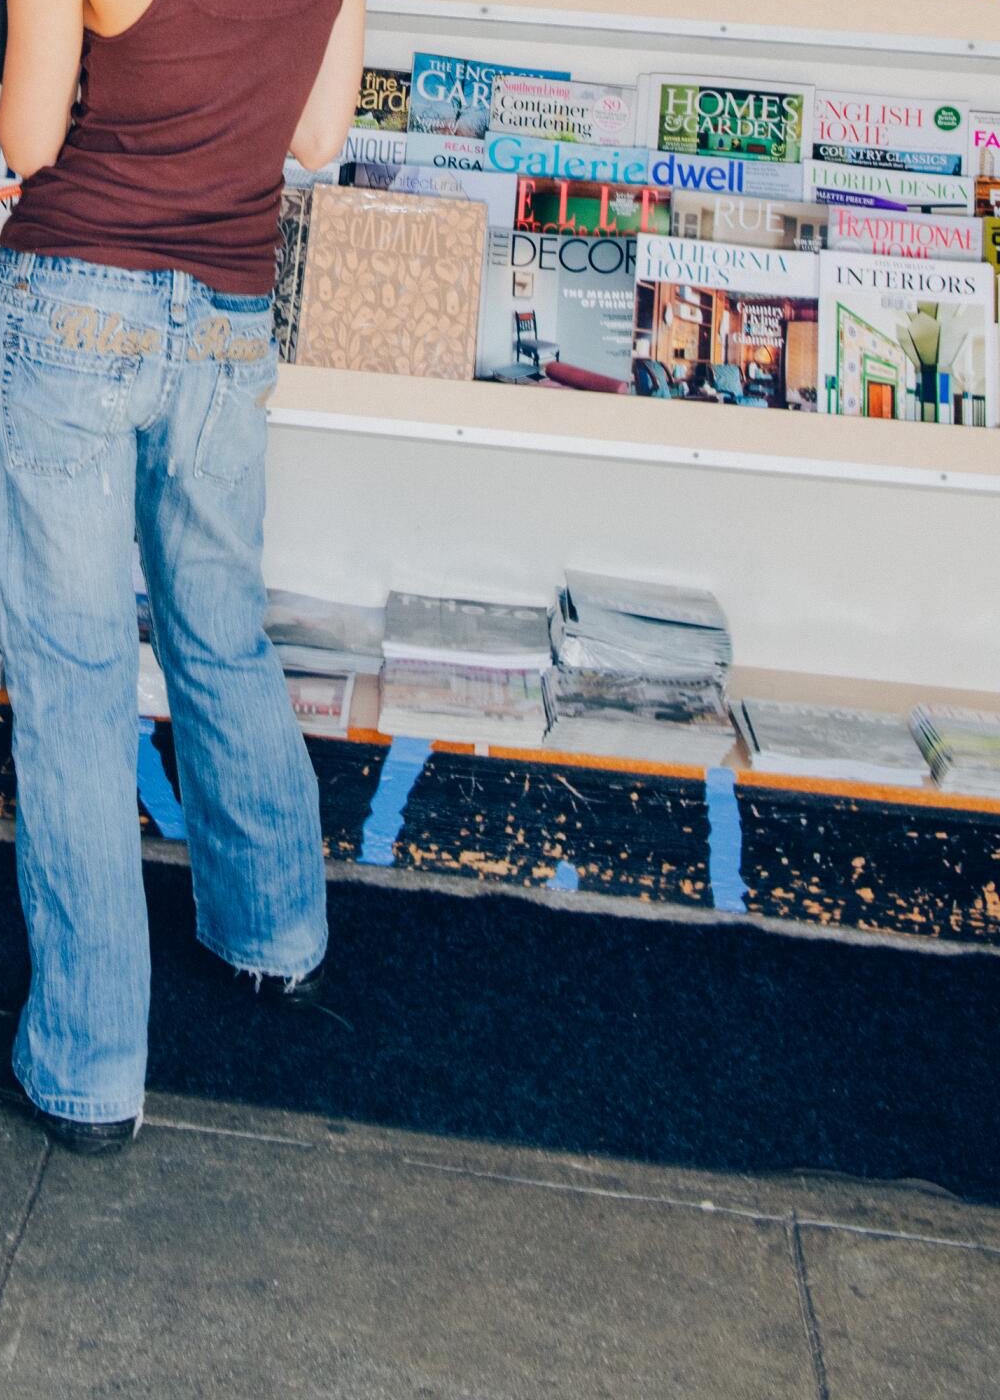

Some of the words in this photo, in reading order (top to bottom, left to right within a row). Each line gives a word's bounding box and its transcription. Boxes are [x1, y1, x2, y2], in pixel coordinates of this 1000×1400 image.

[365, 73, 398, 91] fine
[430, 60, 452, 73] THE
[501, 93, 589, 119] Container
[502, 80, 542, 97] Southern
[543, 84, 570, 99] Living
[665, 88, 798, 123] HOMES
[499, 113, 592, 137] Gardening
[489, 136, 649, 185] Galerie
[652, 152, 743, 192] dwell
[820, 146, 885, 162] COUNTRY
[886, 151, 947, 166] CLASSICS
[811, 167, 892, 194] FLORIDA
[900, 180, 968, 200] DESIGN
[517, 179, 661, 232] ELLE
[714, 198, 785, 233] RUE
[350, 214, 438, 258] CABANA
[832, 207, 977, 252] TRADITIONAL
[511, 233, 637, 275] DECOR
[647, 240, 788, 273] CALIFORNIA
[647, 259, 730, 285] HOMES
[837, 266, 976, 297] INTERIORS
